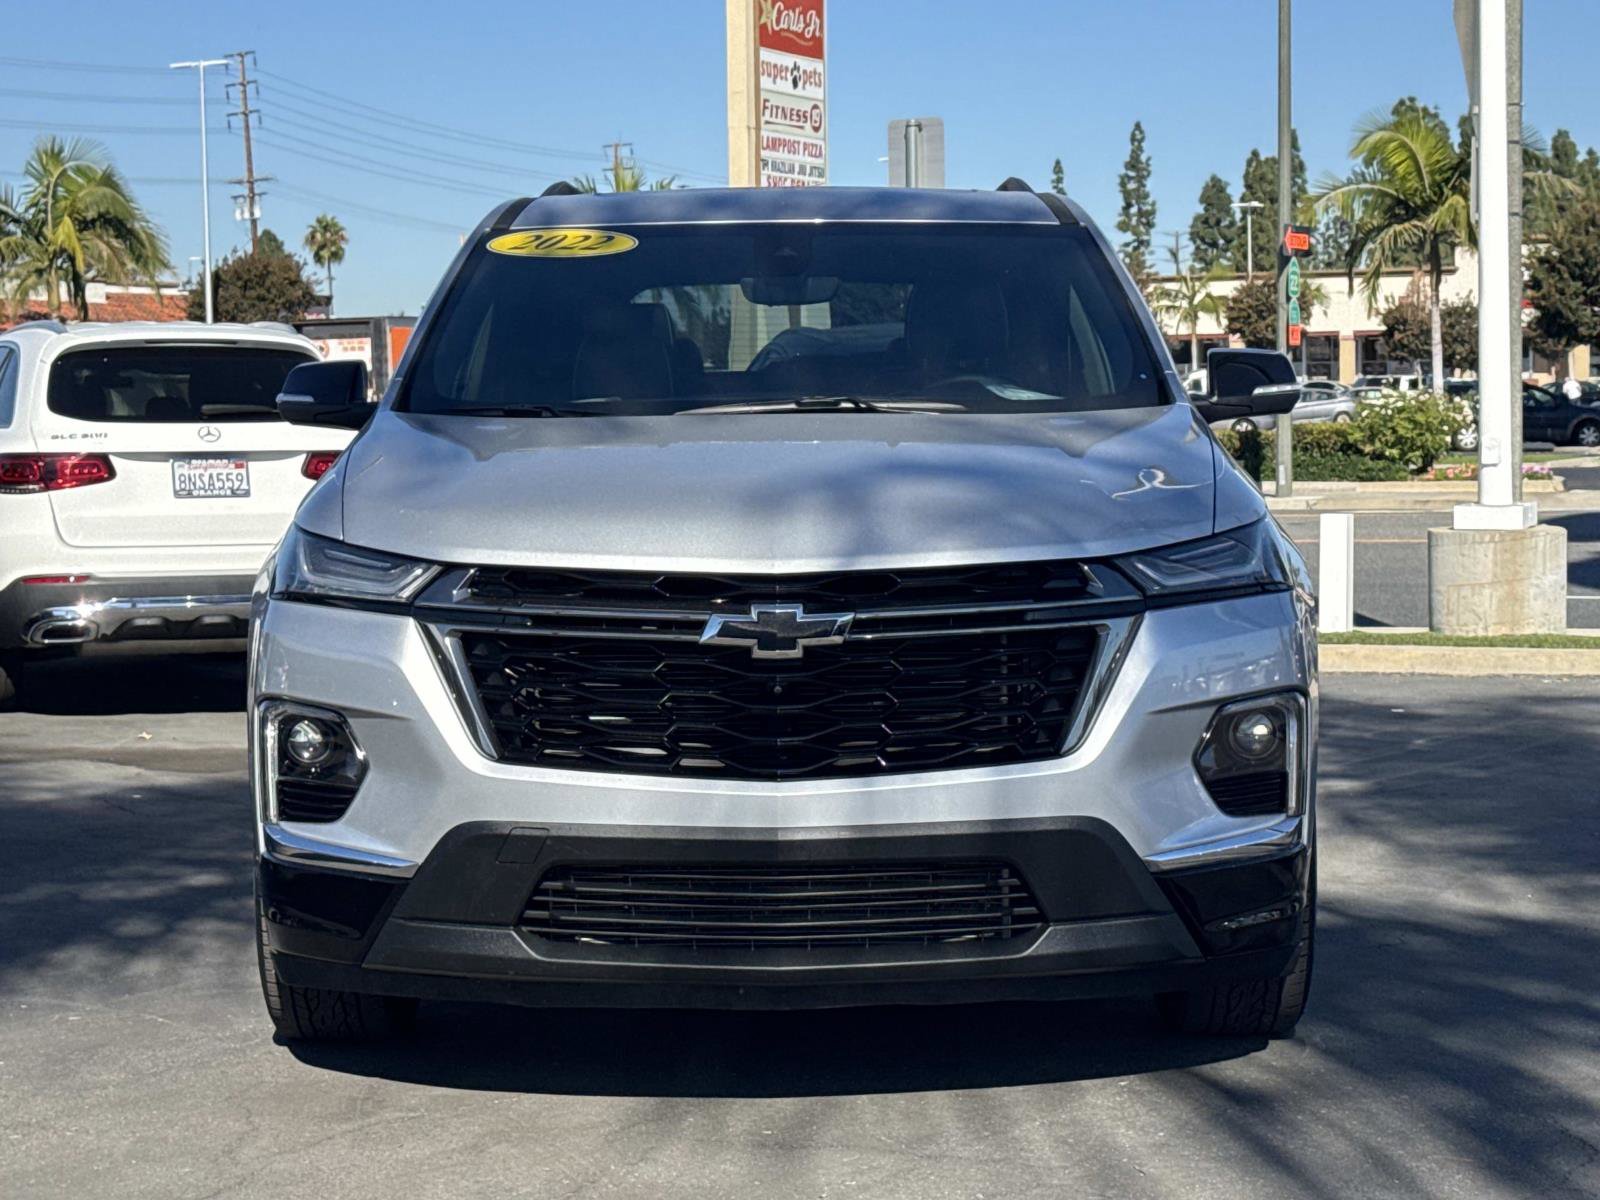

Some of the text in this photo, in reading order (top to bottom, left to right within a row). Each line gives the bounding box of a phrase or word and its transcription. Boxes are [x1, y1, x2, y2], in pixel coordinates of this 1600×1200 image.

[760, 60, 822, 91] super pets
[761, 135, 823, 159] LAMPPOST PIZZA
[507, 234, 616, 251] 2022
[178, 472, 244, 491] 8NSA559
